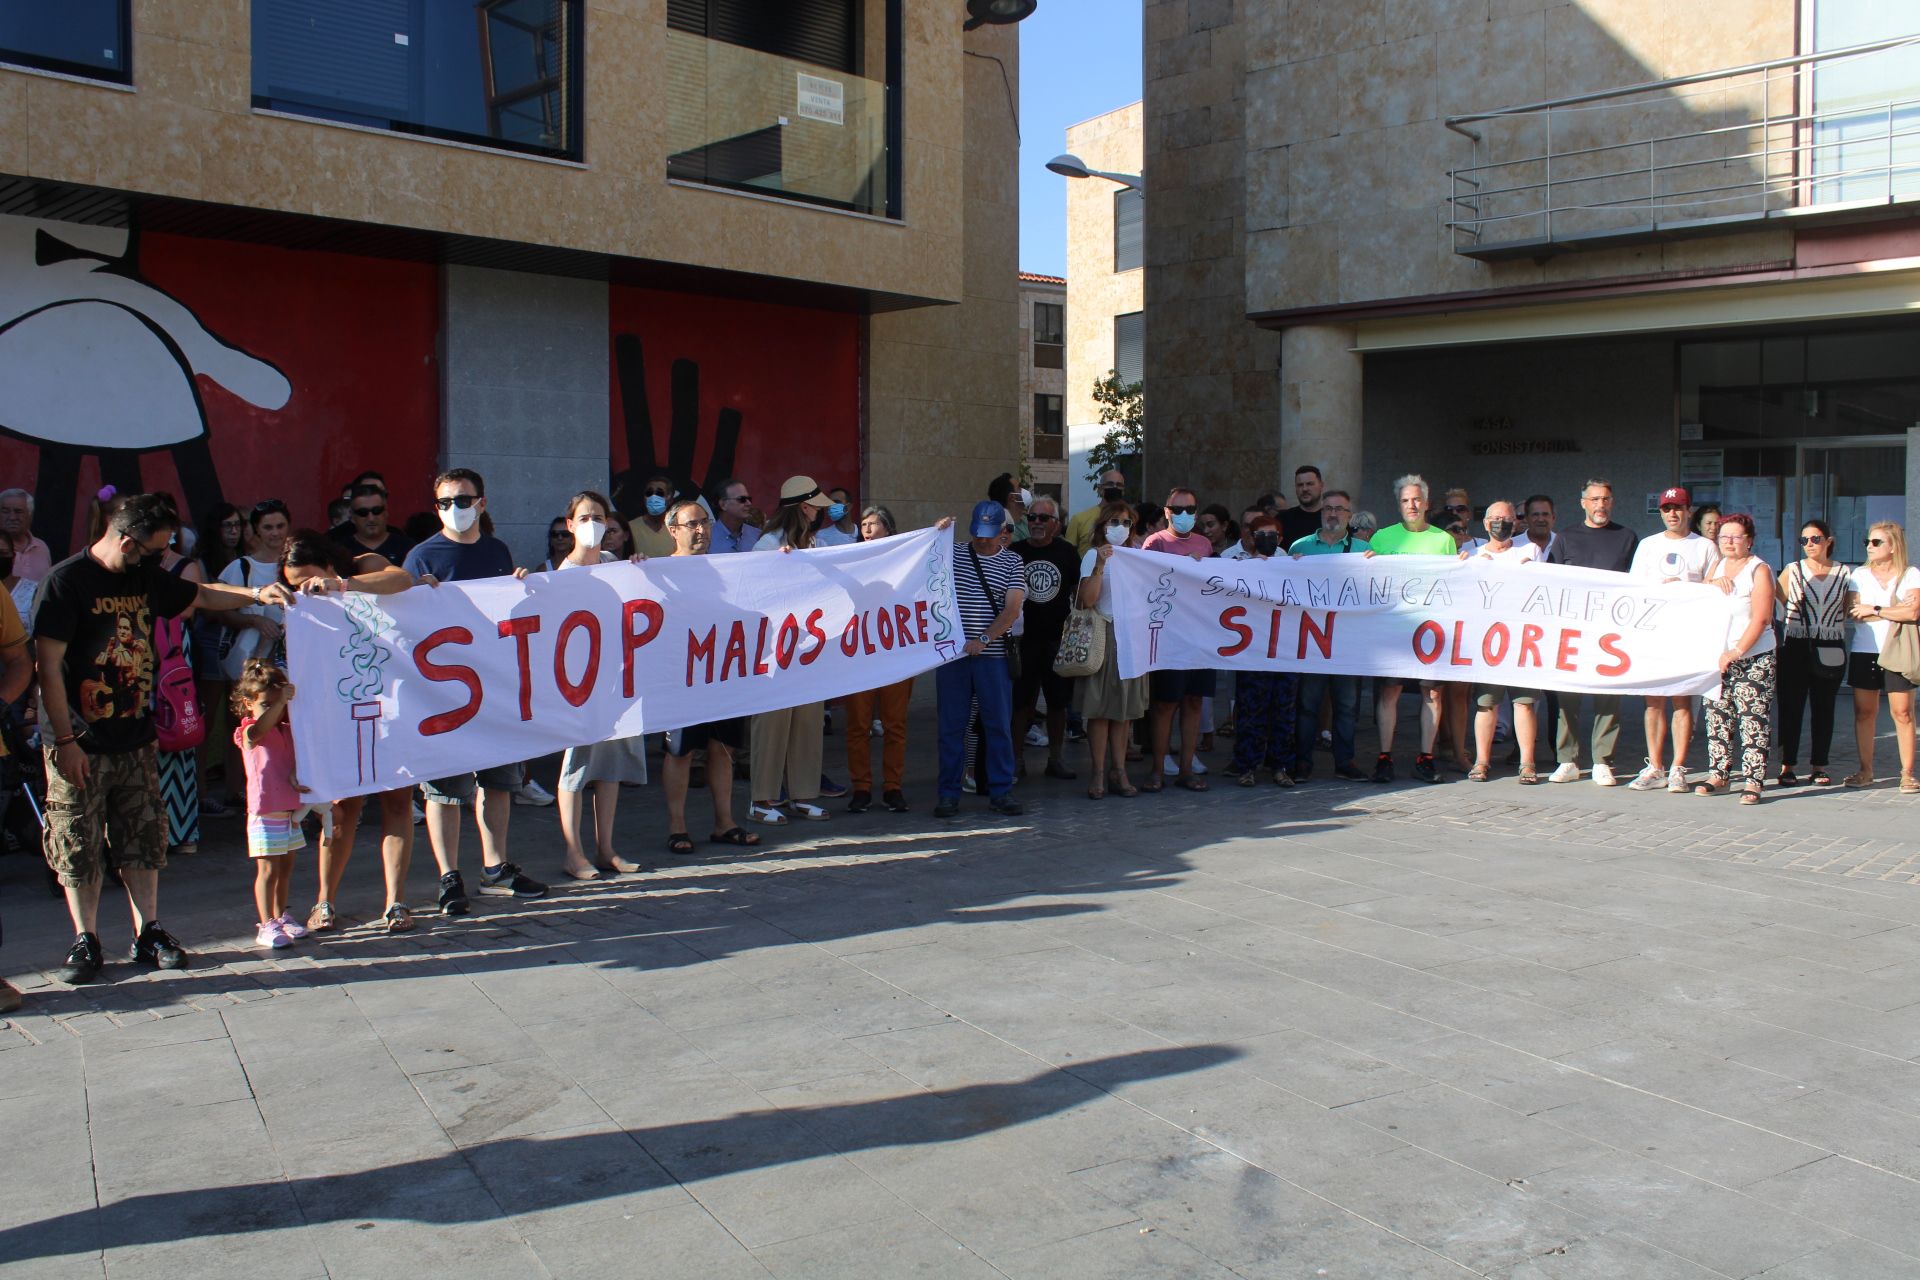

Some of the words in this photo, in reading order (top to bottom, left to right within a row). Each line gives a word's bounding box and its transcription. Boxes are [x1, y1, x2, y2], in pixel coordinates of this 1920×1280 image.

[92, 593, 149, 615] JOHNNY
[1200, 575, 1453, 607] SALAMANCA
[1478, 580, 1504, 609] Y
[1521, 585, 1668, 631] ALFOZ
[412, 598, 665, 736] STOP
[686, 608, 826, 687] MALOS
[840, 600, 951, 657] OLORES
[1217, 605, 1337, 659] SIN
[1412, 619, 1631, 677] OLORES
